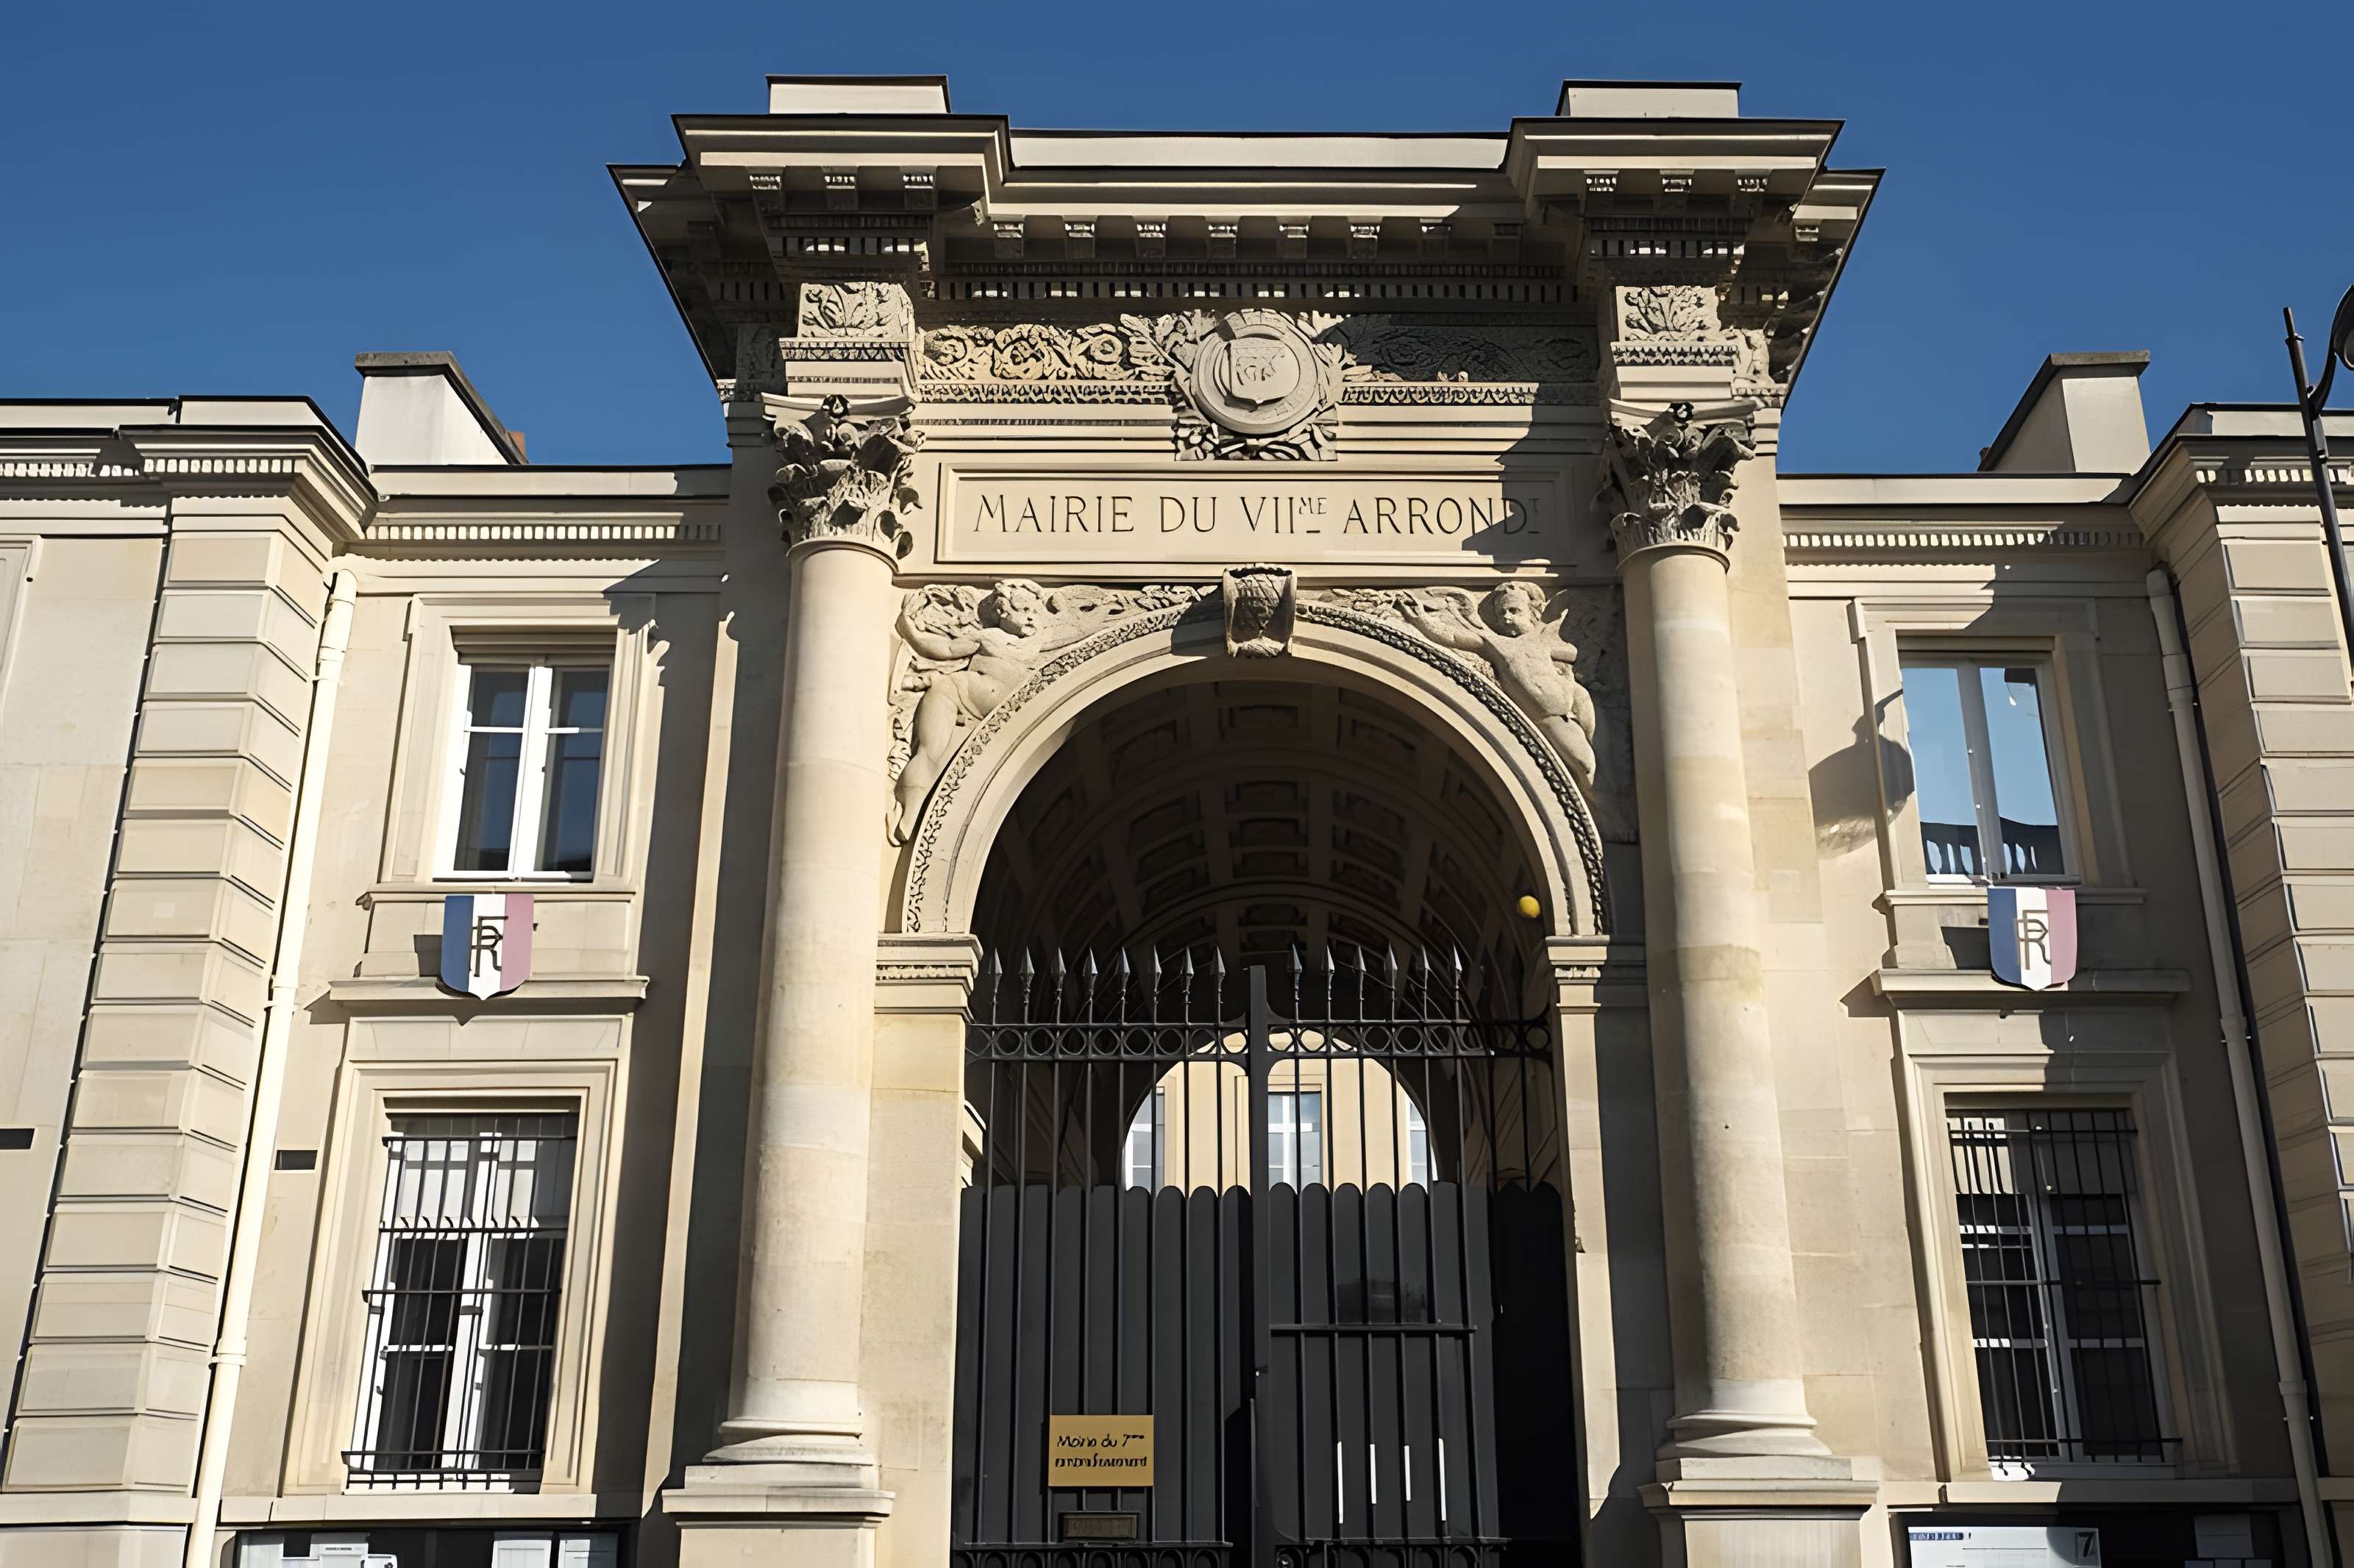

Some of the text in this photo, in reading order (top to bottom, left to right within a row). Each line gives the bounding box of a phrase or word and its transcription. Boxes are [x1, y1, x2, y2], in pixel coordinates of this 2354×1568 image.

[974, 494, 1134, 532] MAIRIE
[1159, 496, 1217, 532] DU
[1101, 1433, 1117, 1447] du
